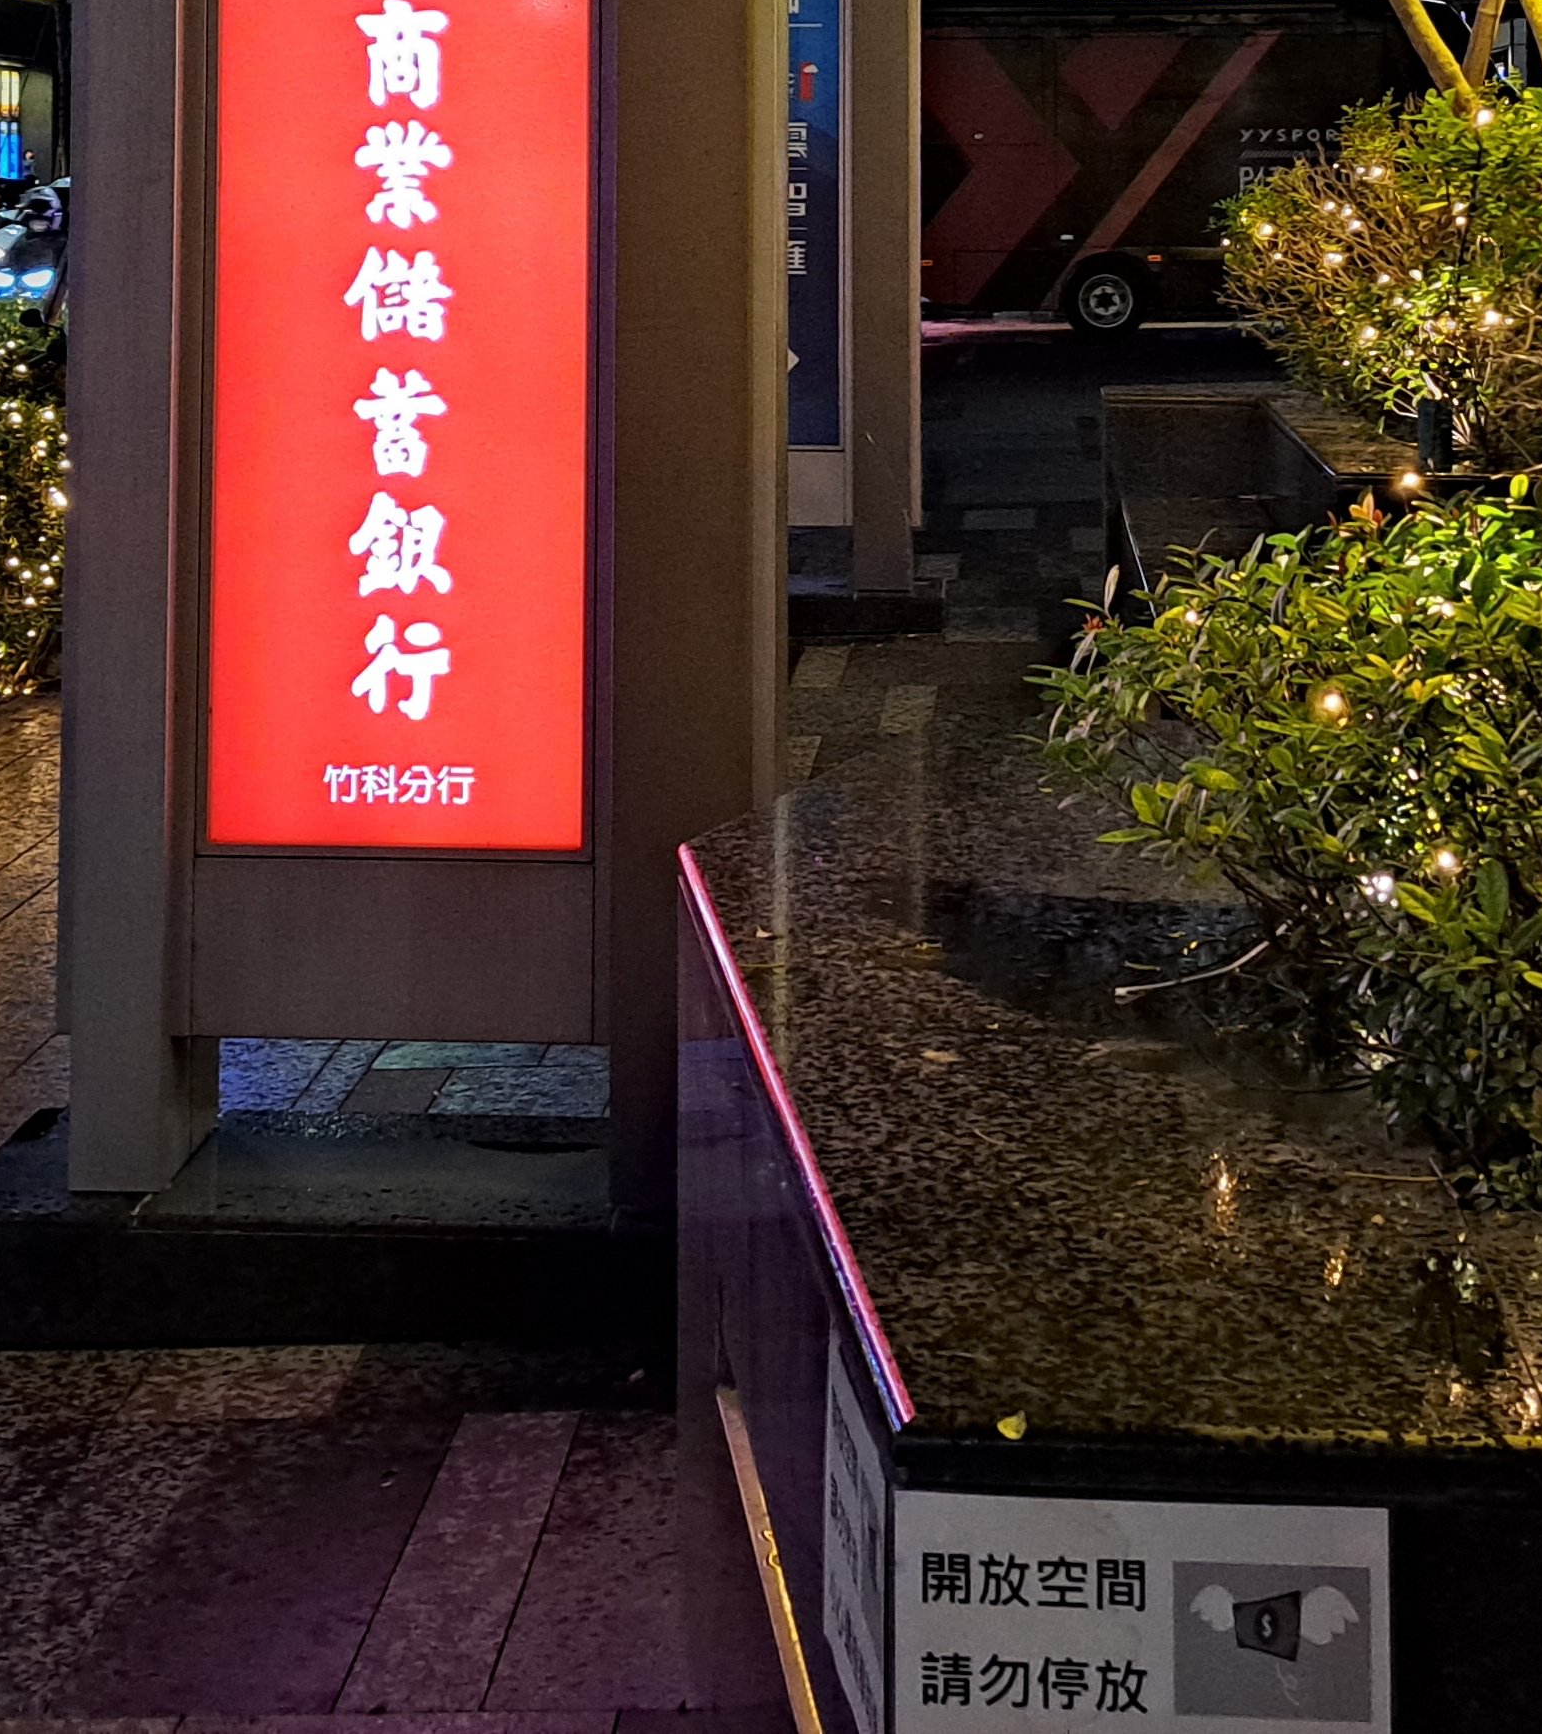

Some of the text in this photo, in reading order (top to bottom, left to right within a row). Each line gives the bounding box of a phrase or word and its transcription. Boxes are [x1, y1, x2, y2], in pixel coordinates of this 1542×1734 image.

[323, 765, 475, 804] 竹科分行
[921, 1551, 1146, 1613] 開放空間
[920, 1651, 1148, 1714] 請勿停放
